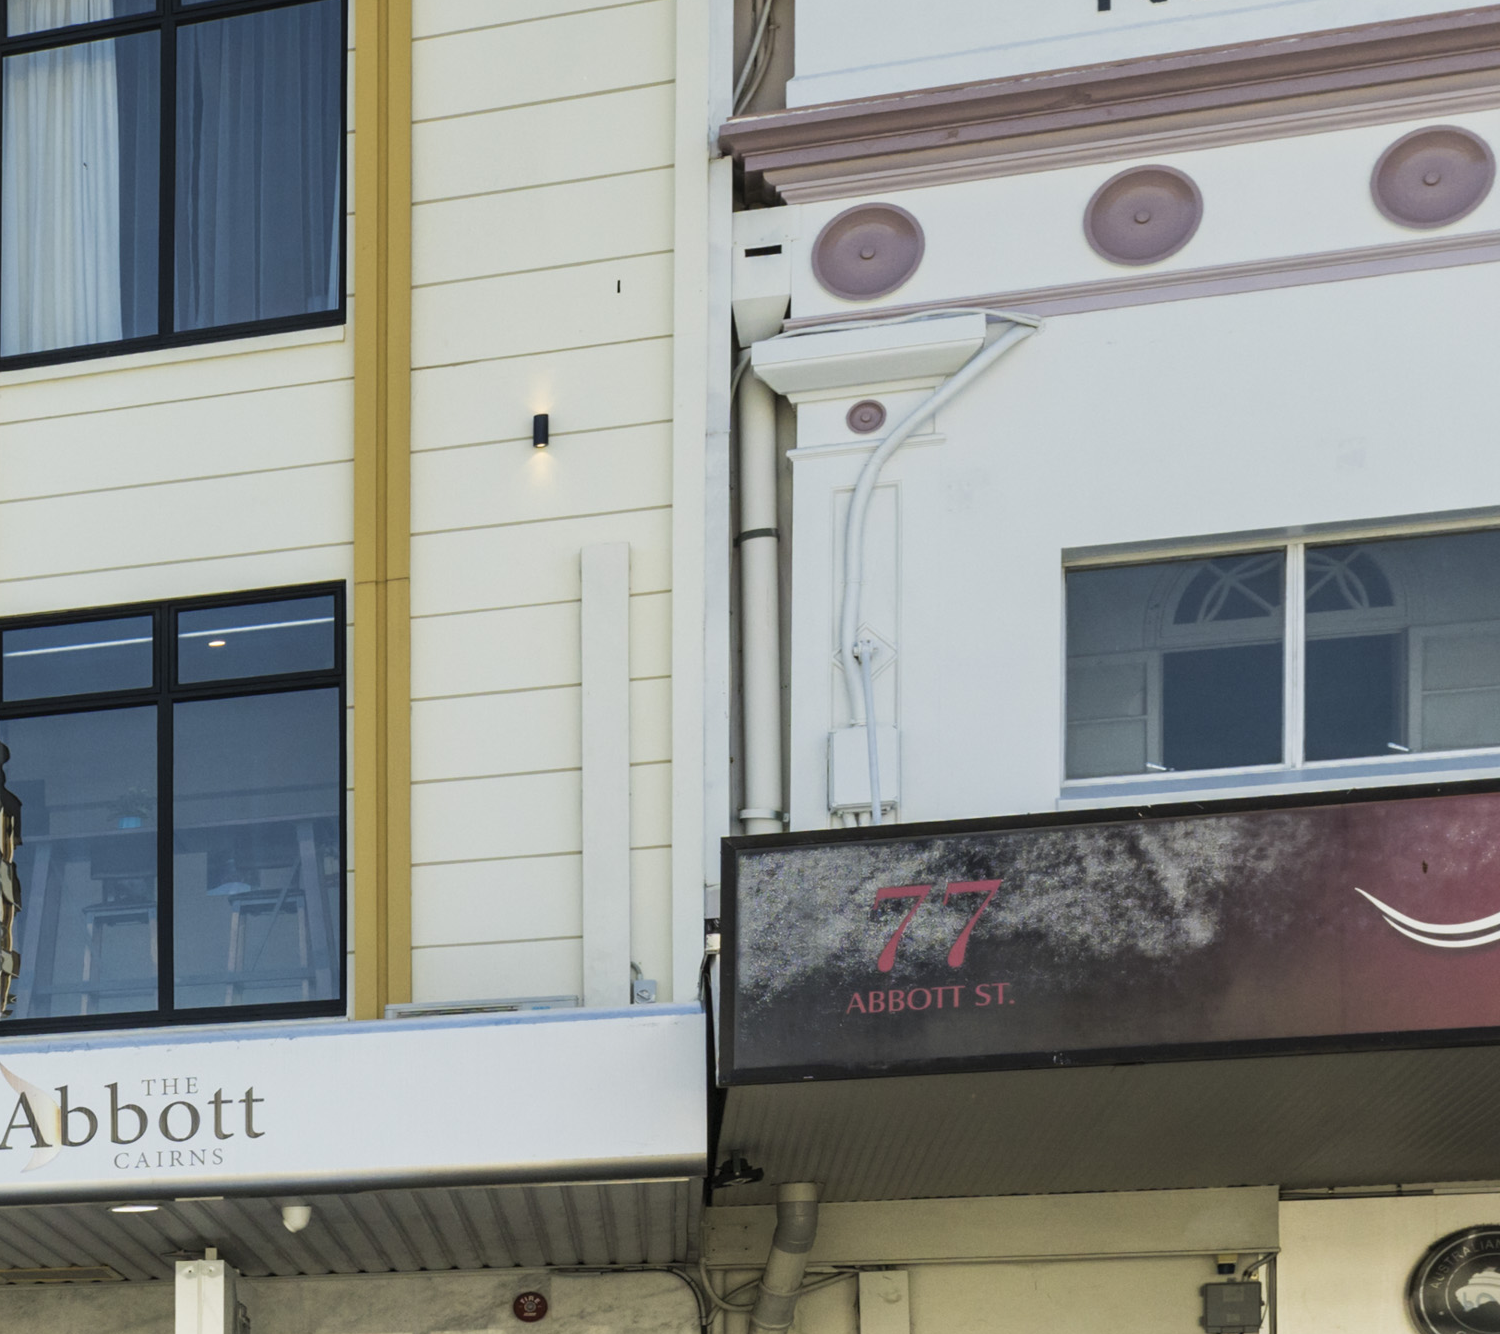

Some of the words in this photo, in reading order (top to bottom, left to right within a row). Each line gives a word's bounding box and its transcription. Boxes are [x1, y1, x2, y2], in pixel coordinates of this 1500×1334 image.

[873, 879, 1003, 973] 77
[846, 984, 966, 1015] ABBOTT
[974, 982, 1016, 1007] ST.
[141, 1076, 199, 1097] THE
[113, 1148, 225, 1170] CAIRNS
